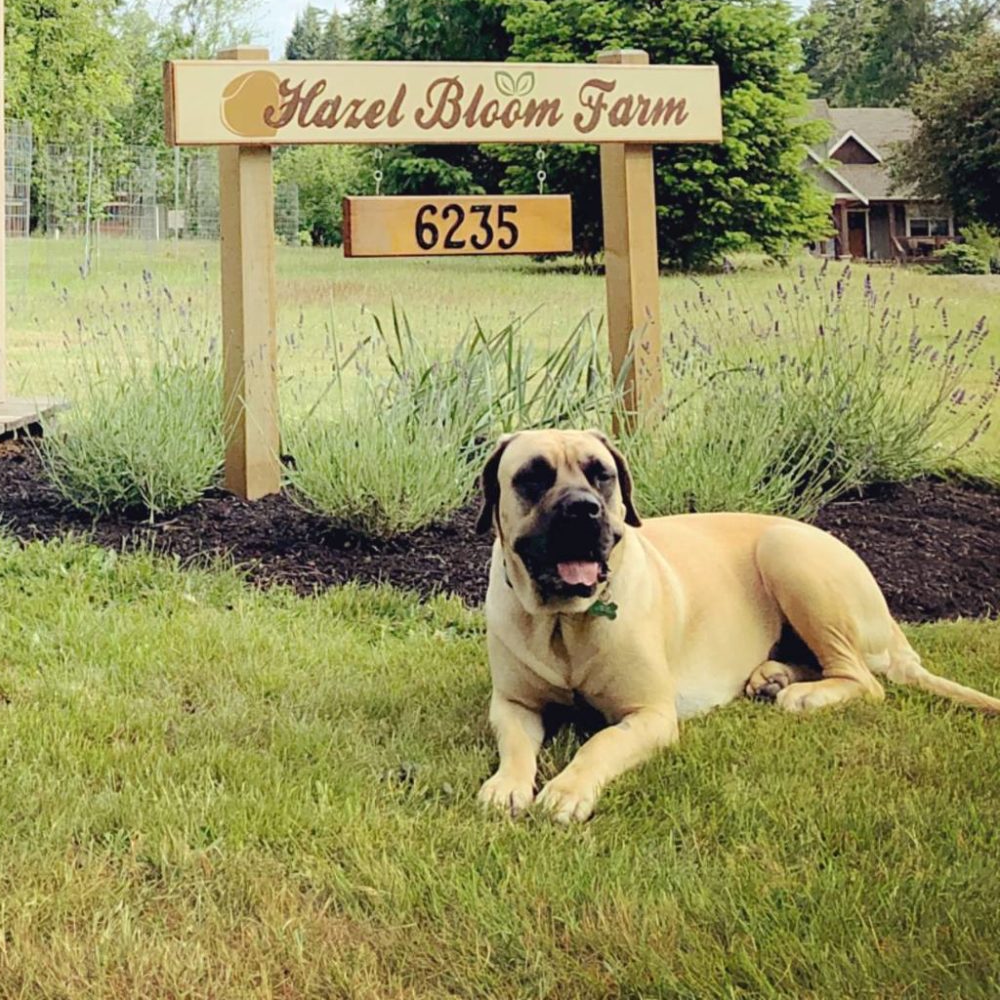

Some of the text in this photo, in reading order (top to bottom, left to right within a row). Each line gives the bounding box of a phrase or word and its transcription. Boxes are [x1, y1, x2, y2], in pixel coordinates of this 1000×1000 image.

[263, 74, 689, 134] Hazel Bloom Farm
[414, 203, 520, 251] 6235
